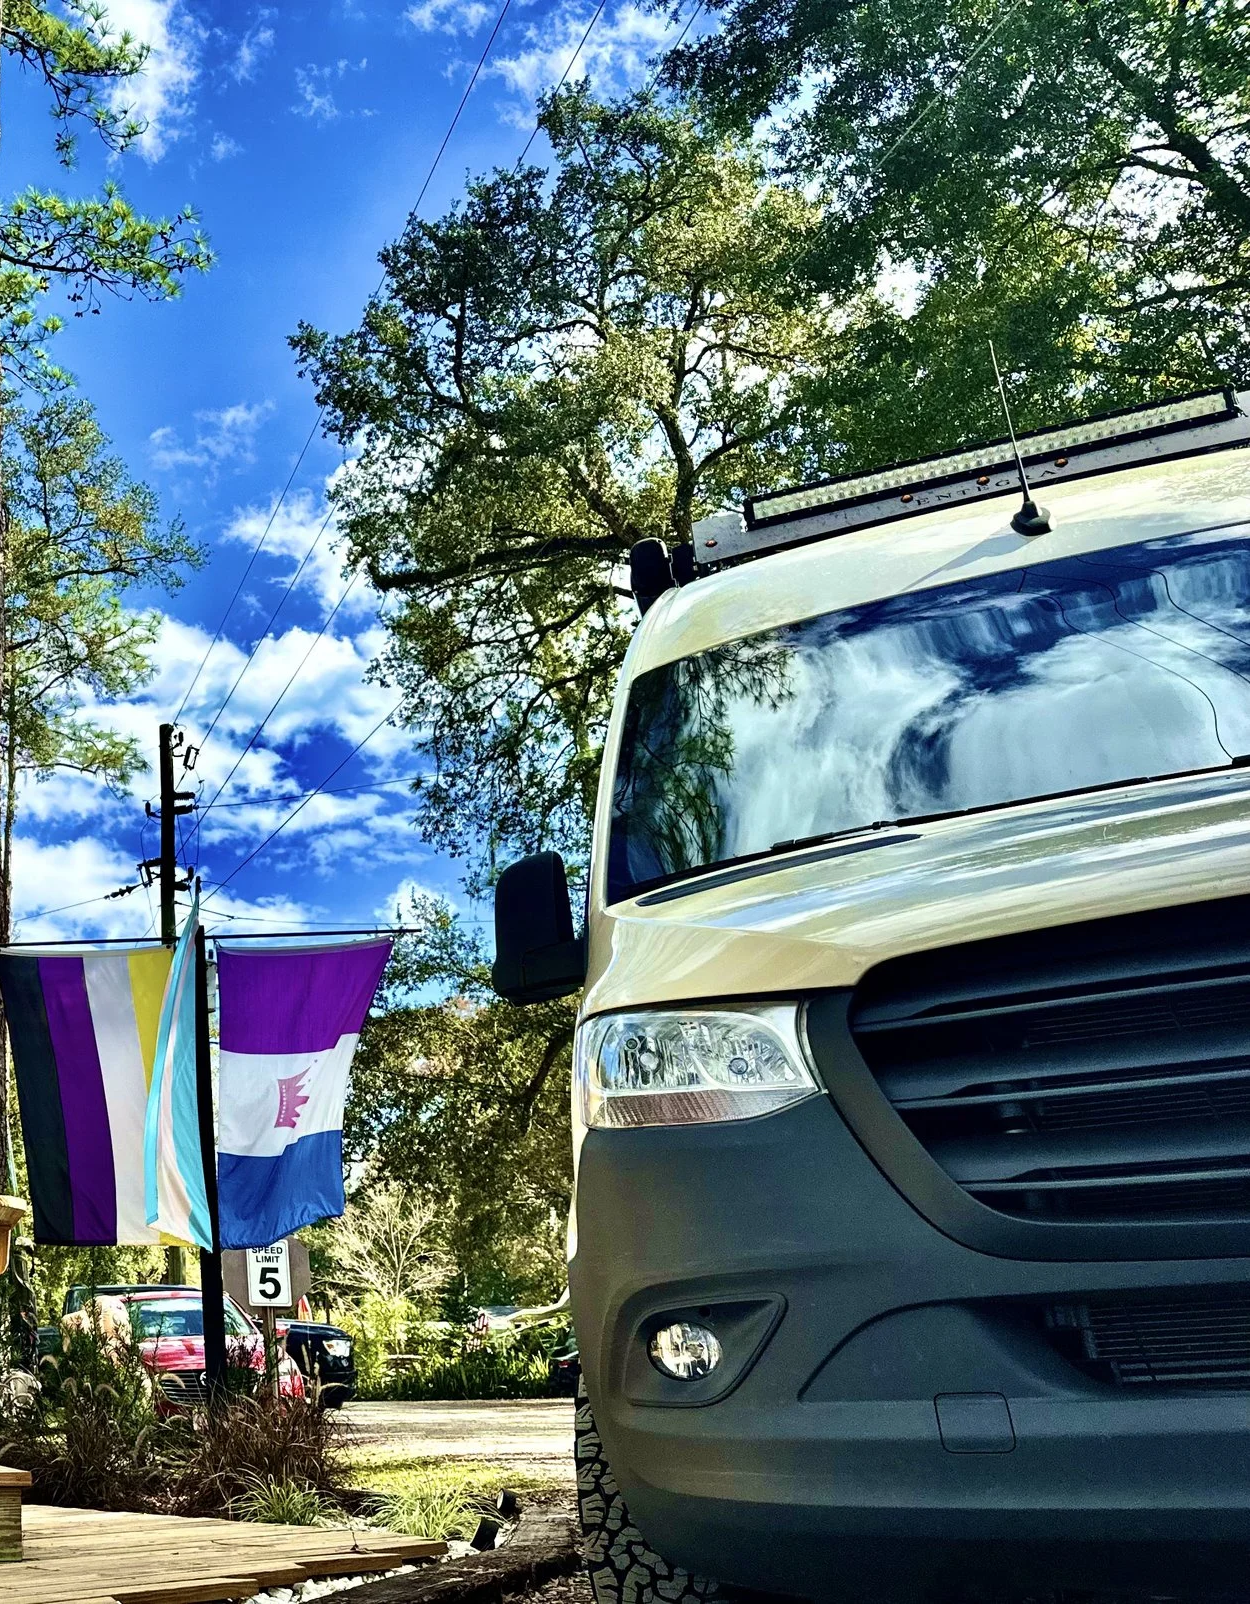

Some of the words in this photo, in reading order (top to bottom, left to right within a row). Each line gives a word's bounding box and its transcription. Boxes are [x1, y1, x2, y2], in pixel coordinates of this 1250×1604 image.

[251, 1246, 283, 1254] SPEED
[255, 1255, 280, 1263] LIMIT
[258, 1266, 282, 1300] 5
